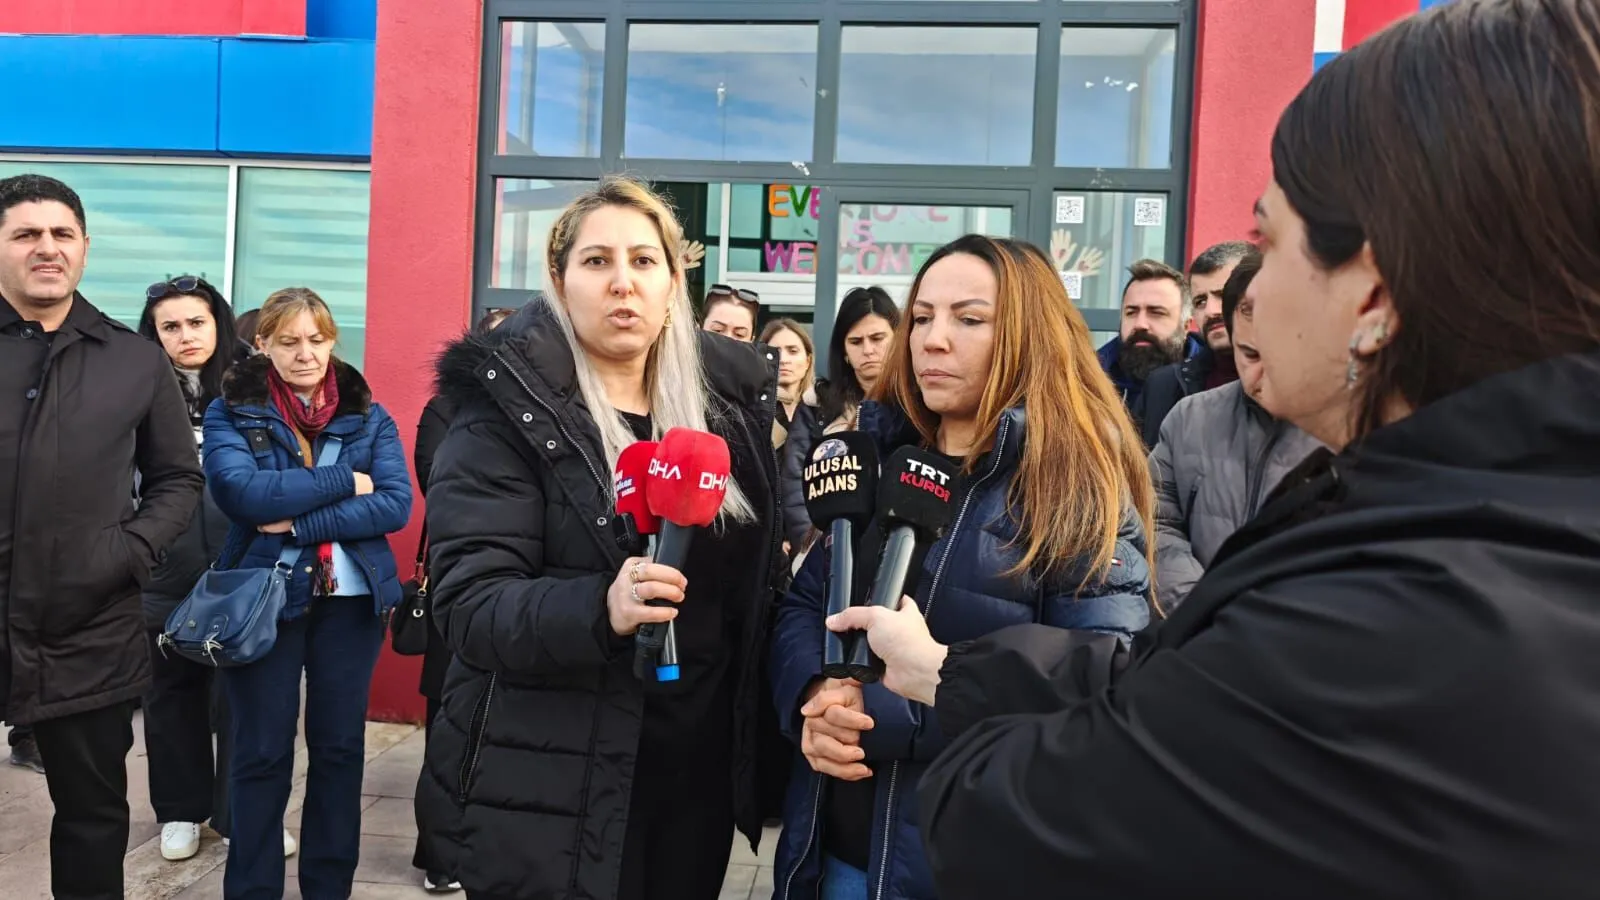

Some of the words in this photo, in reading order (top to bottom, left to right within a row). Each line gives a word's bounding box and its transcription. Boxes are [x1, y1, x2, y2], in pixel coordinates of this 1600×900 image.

[768, 184, 949, 222] EVEONE
[647, 457, 682, 480] DHA
[804, 455, 862, 482] ULUSAL
[906, 458, 950, 486] TRT
[808, 474, 858, 500] AJANS
